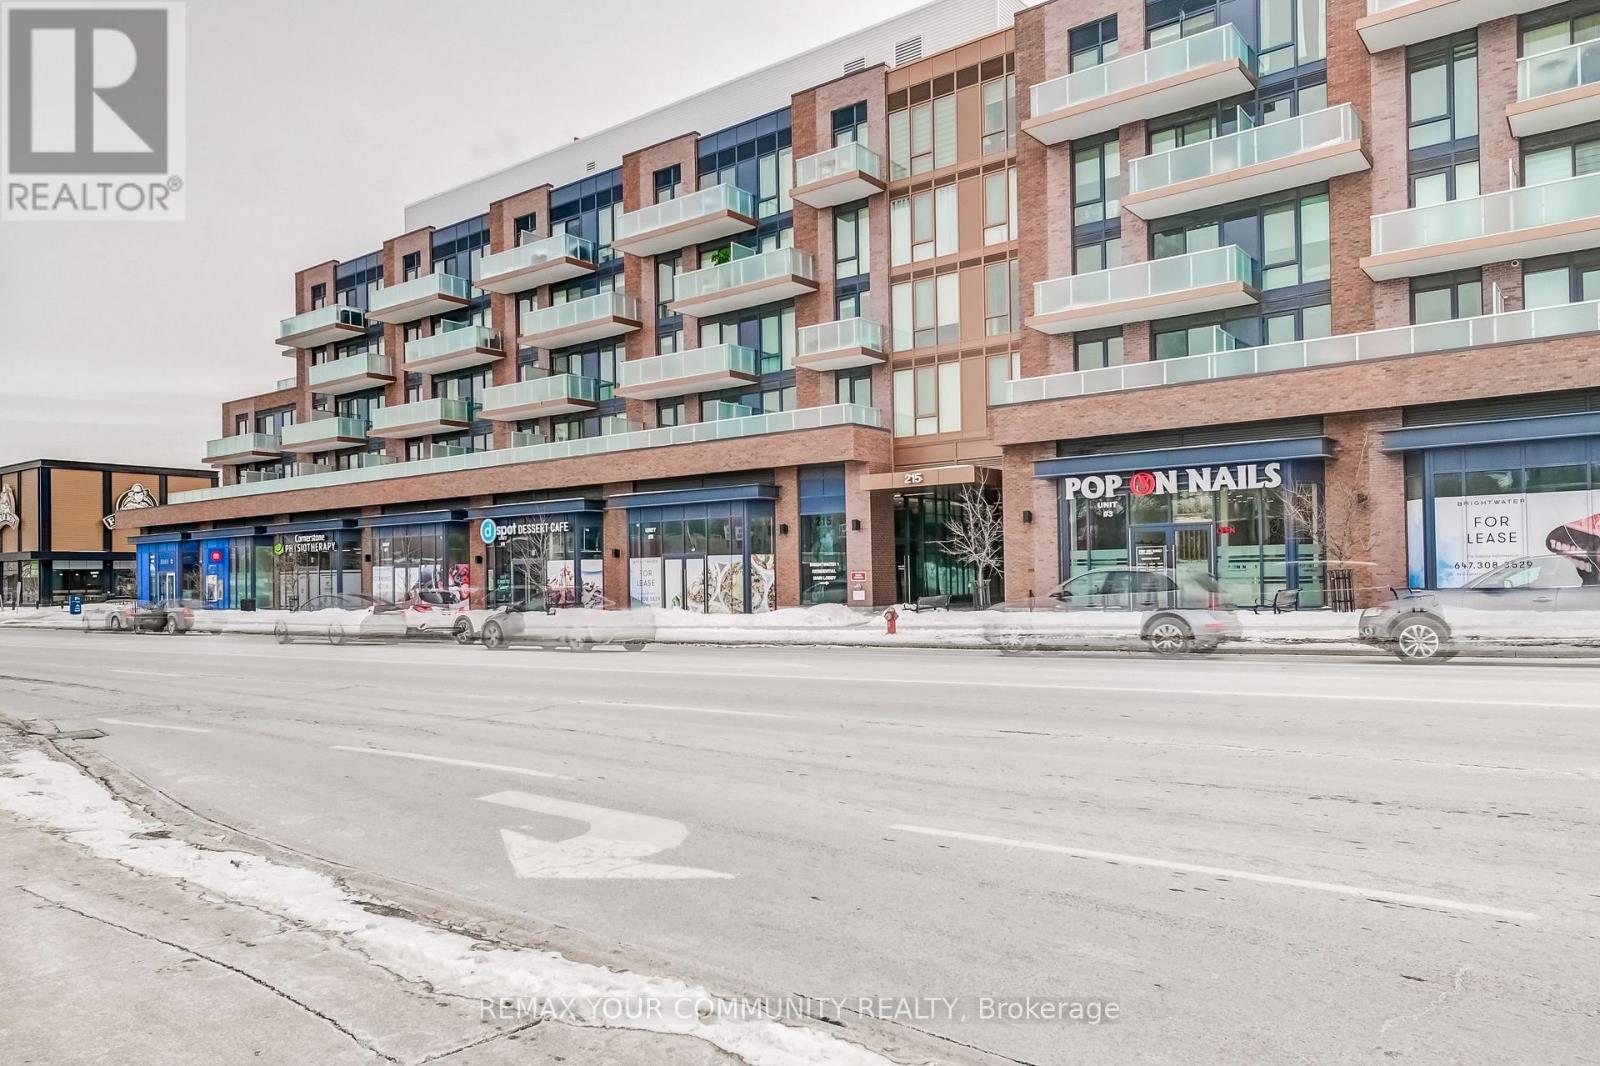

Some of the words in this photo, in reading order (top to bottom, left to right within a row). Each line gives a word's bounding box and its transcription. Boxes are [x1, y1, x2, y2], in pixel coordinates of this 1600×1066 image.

[904, 473, 923, 484] 215
[1065, 475, 1123, 500] POP
[1186, 462, 1282, 492] NAILS
[1097, 501, 1118, 509] UNIT
[1457, 499, 1526, 507] BRIGHTWATER
[518, 523, 549, 535] DESSERT
[550, 521, 569, 533] CAFE
[1474, 516, 1510, 528] FOR
[294, 534, 326, 543] Cornerstone
[1467, 532, 1517, 544] LEASE
[285, 541, 336, 553] PHYSIOTHERAPY
